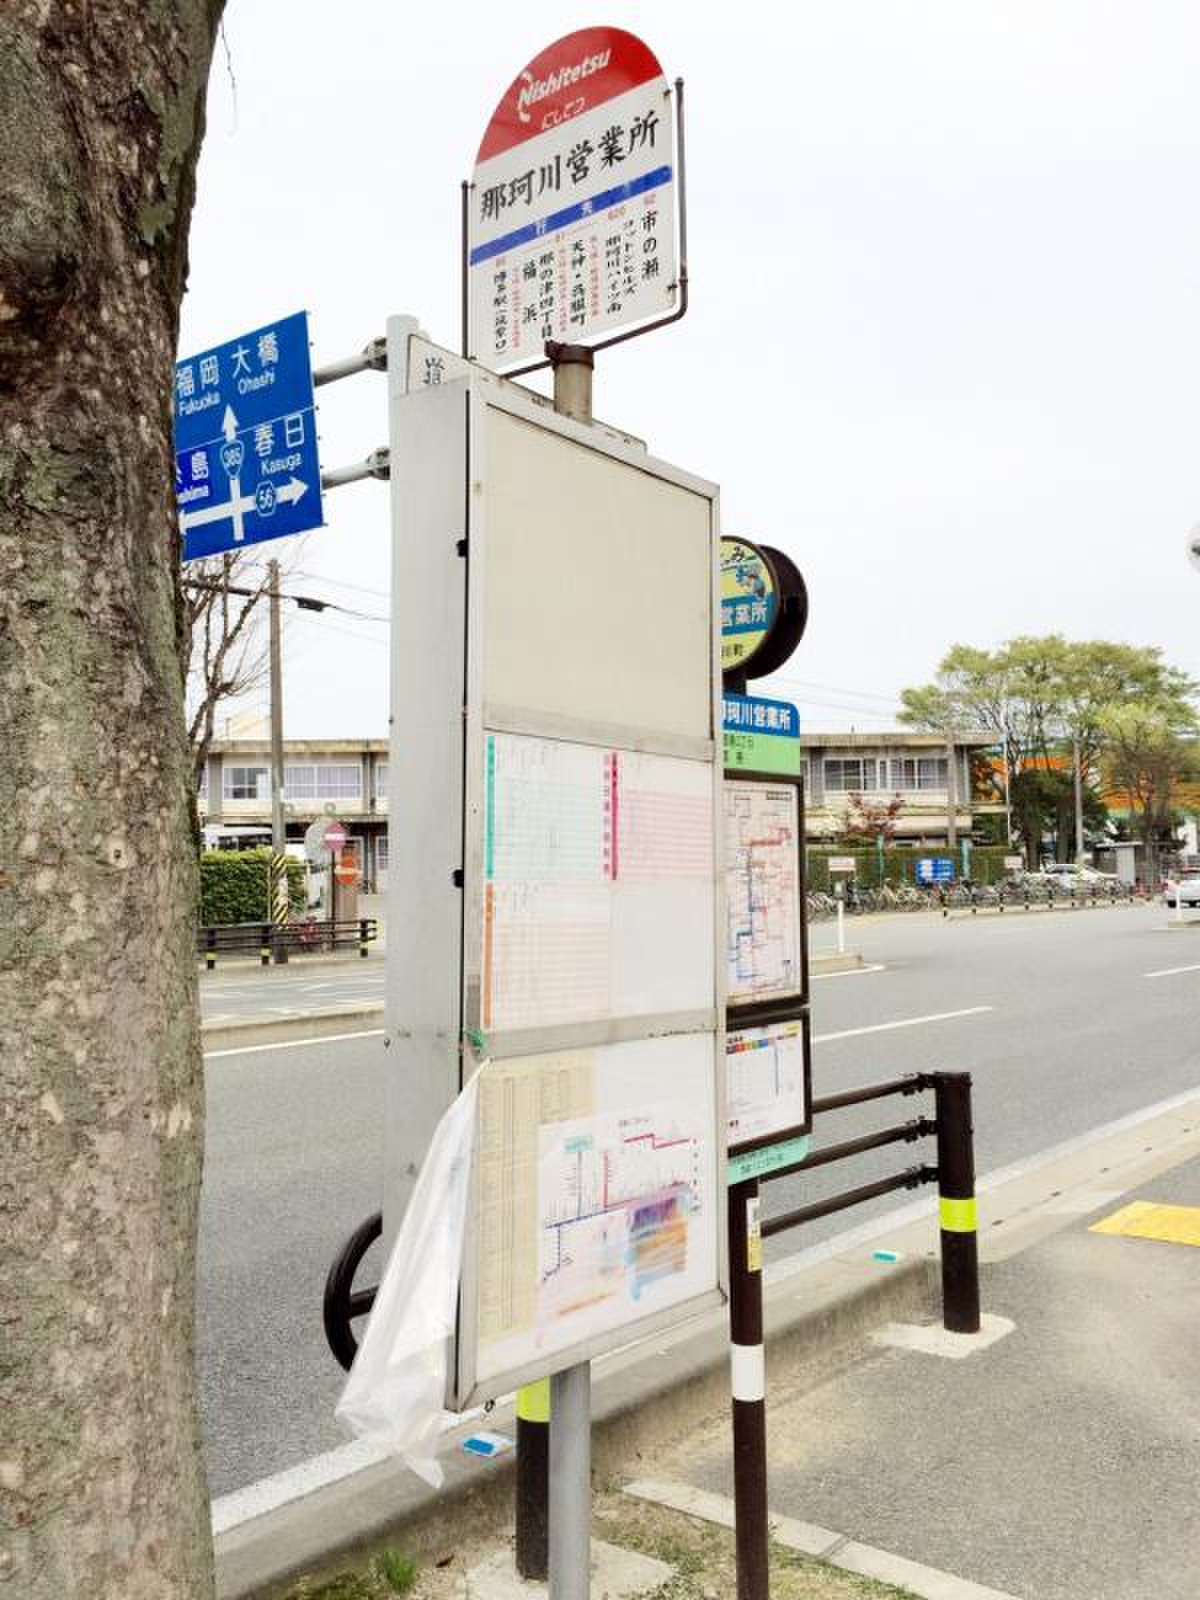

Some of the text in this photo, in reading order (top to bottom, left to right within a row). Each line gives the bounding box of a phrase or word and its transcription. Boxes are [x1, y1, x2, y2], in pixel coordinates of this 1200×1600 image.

[517, 48, 612, 123] Nishitetsu
[479, 109, 661, 222] 那珂川営業所
[230, 331, 279, 379] 大橋
[237, 369, 276, 395] Ohashi
[254, 413, 305, 459] 春日
[260, 451, 303, 477] Kasuga
